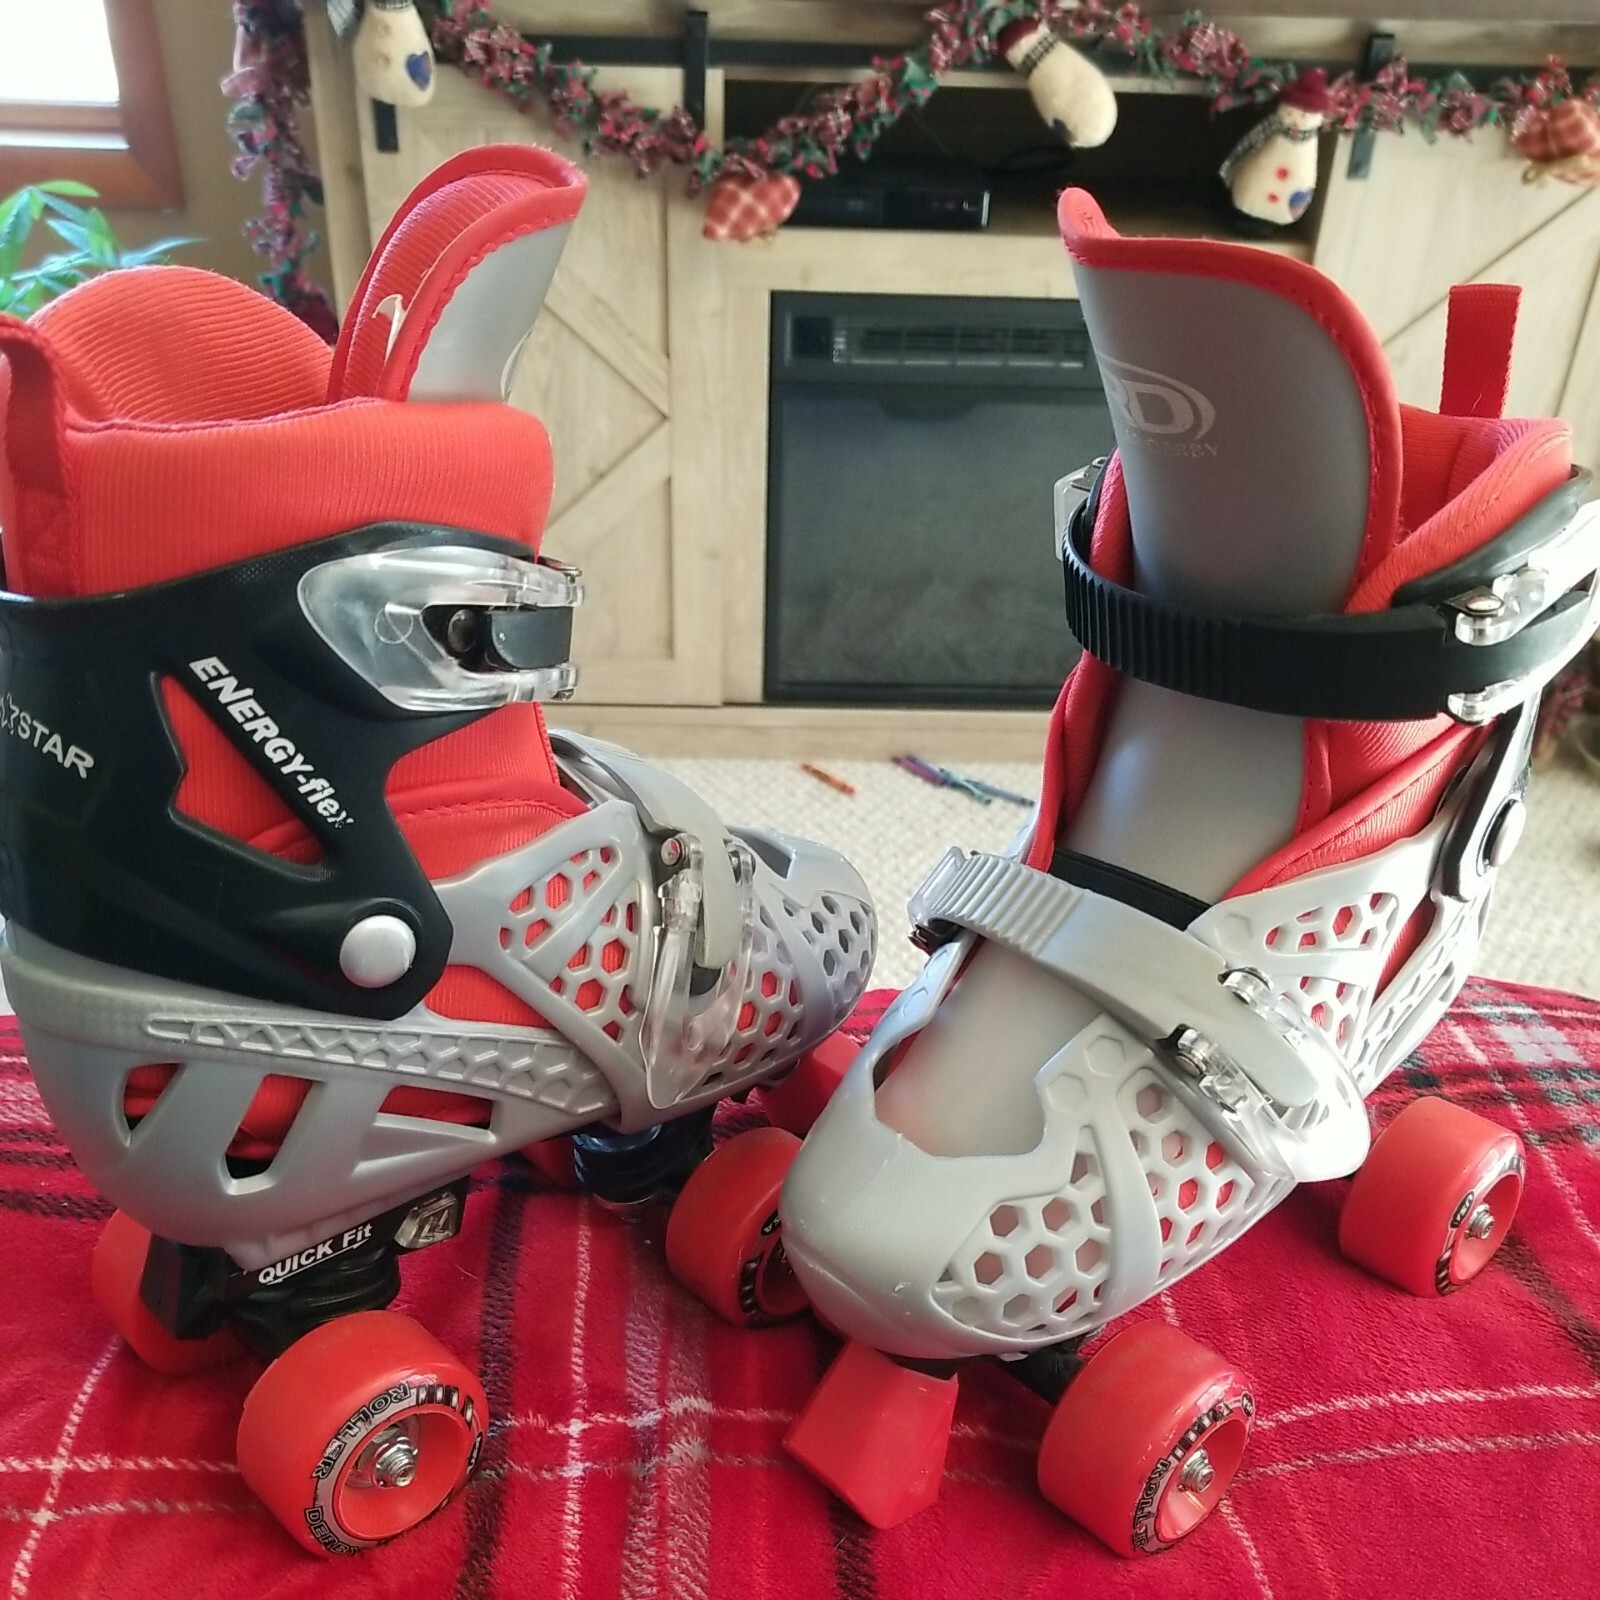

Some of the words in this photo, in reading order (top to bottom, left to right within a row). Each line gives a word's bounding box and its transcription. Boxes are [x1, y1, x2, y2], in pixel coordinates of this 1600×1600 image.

[189, 656, 355, 829] ENERGY-flex
[258, 1238, 334, 1285] QUICK
[342, 1222, 373, 1249] Fit
[311, 1380, 414, 1480] ROLLER
